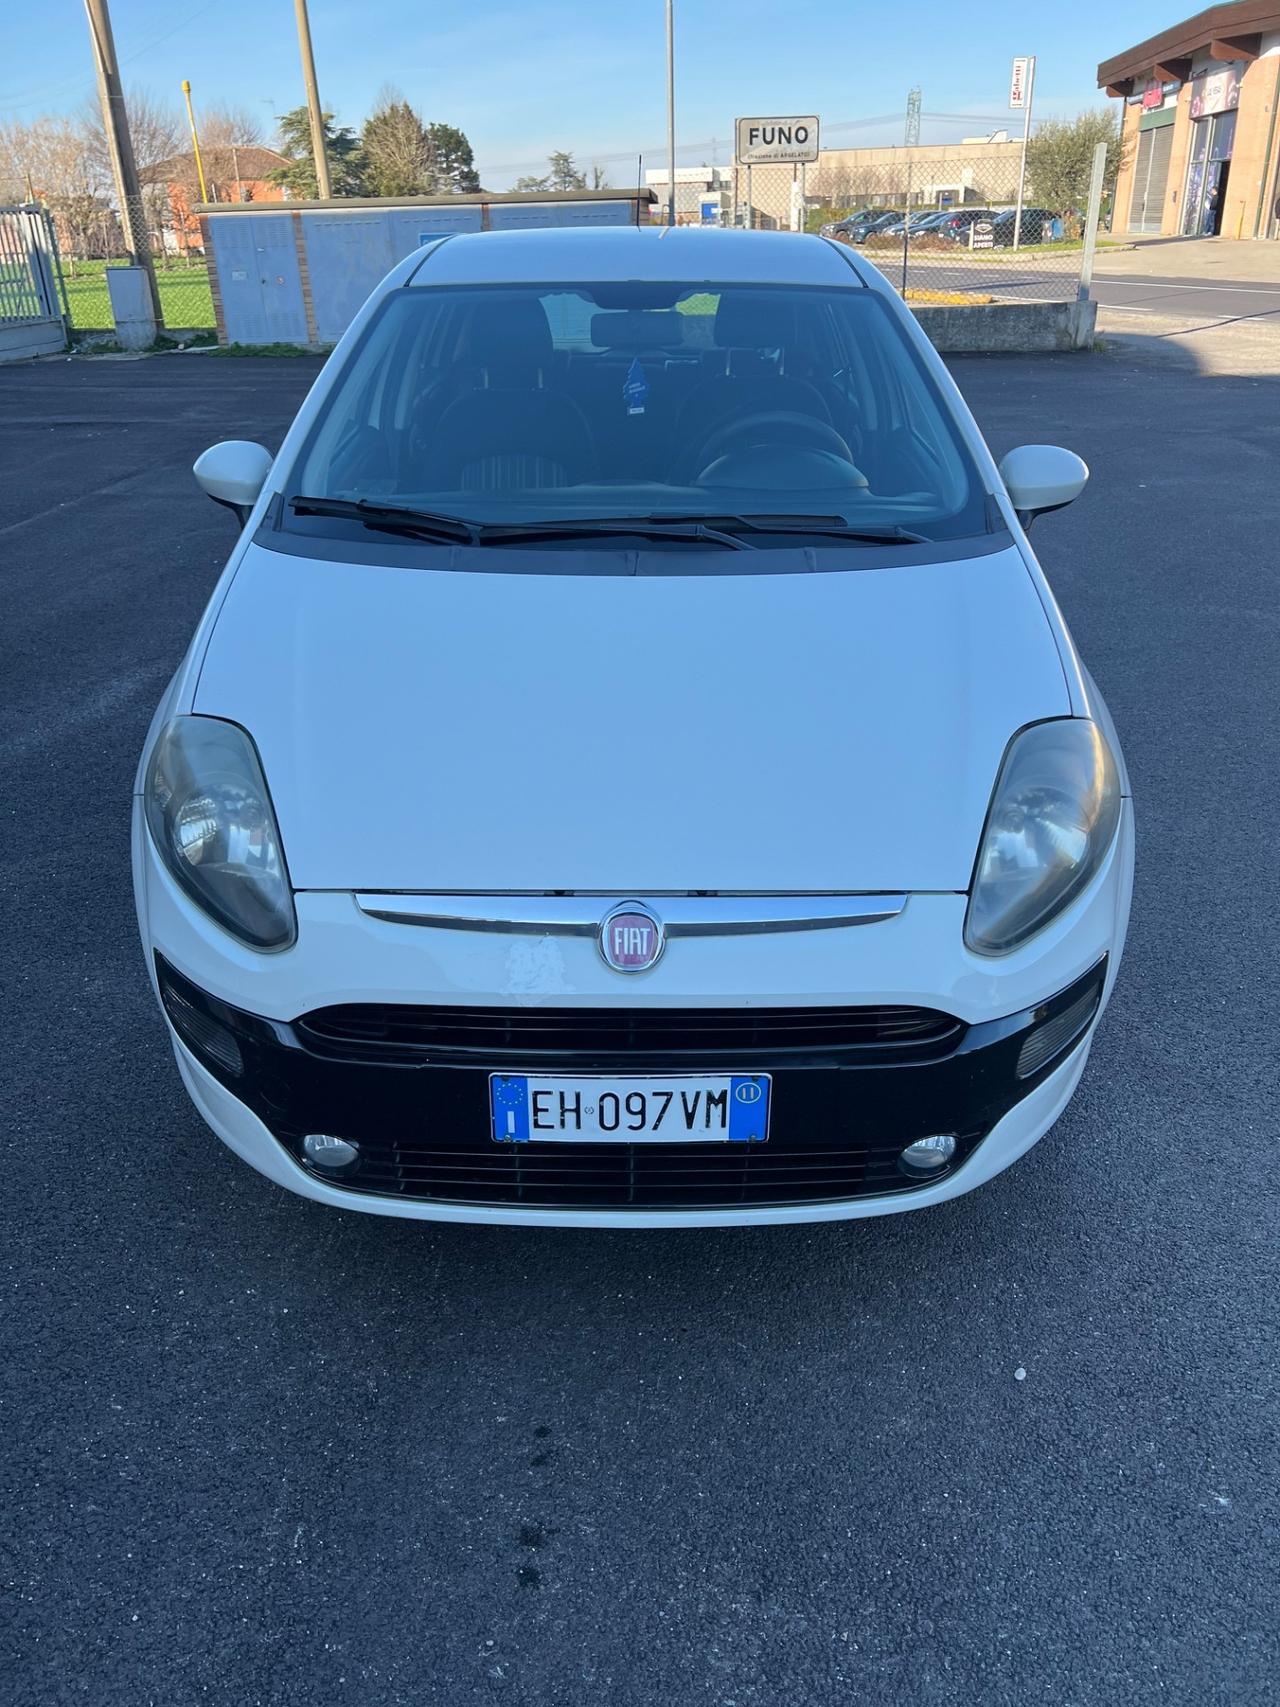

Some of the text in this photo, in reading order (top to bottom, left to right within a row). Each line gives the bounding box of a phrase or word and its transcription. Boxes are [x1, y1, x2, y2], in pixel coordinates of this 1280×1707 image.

[749, 126, 809, 146] FUNO
[614, 927, 651, 955] FIAT
[507, 1111, 515, 1133] I
[531, 1089, 728, 1131] EH 097VM
